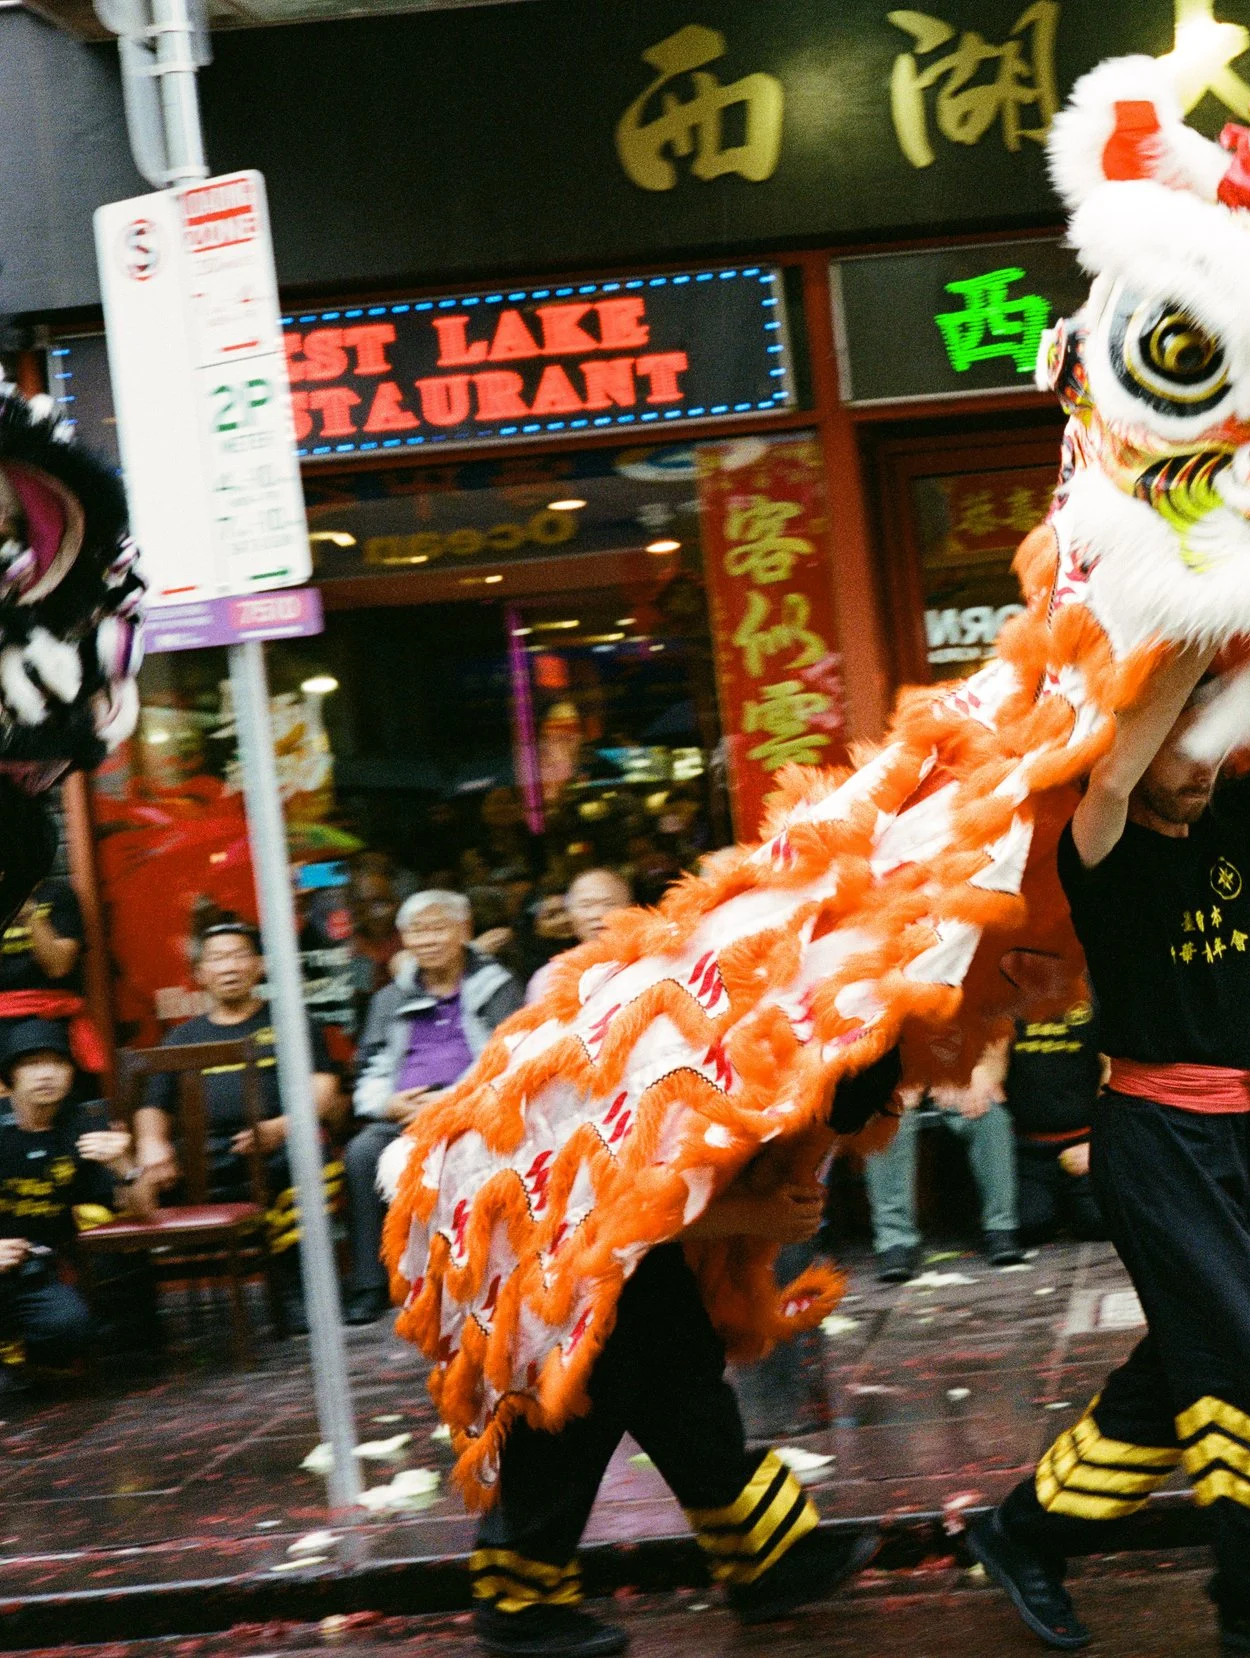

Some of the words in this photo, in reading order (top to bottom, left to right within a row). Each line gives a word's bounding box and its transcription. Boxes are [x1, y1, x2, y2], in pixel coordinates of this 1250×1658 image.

[432, 297, 650, 367] LAKE
[935, 266, 1052, 373] 西
[211, 377, 276, 433] 2P
